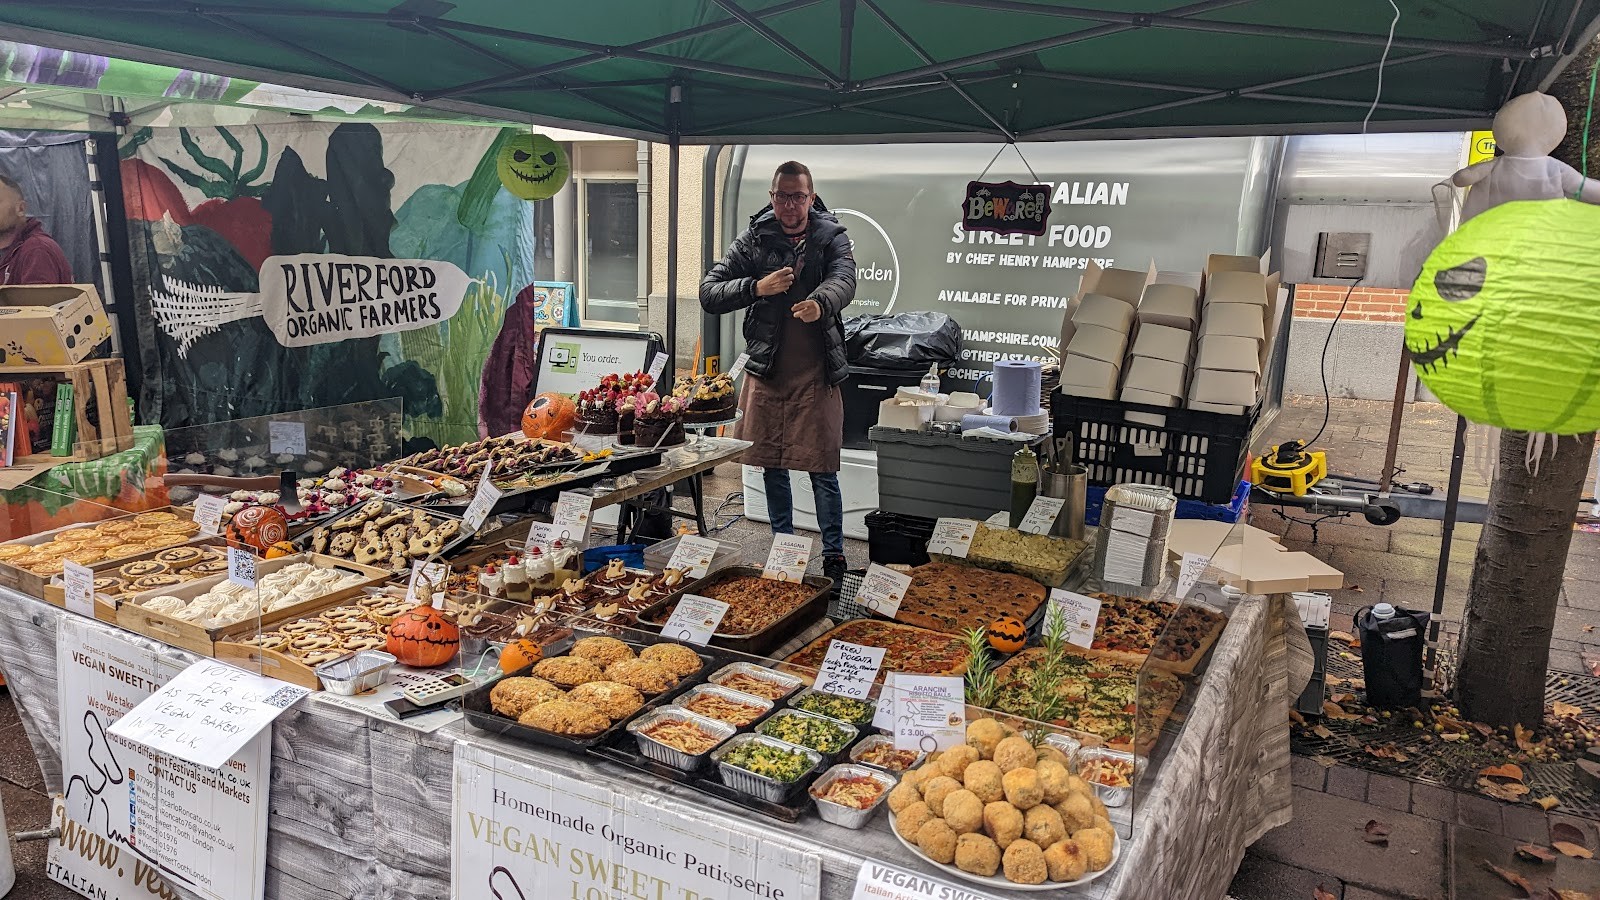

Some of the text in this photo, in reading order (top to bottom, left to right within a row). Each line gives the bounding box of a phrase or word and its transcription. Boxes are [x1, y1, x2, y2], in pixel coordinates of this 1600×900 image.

[1033, 181, 1130, 205] ALIAN
[1048, 224, 1112, 249] FOOD
[947, 252, 1115, 270] BY CHEF HENRY HAMPSRE
[280, 262, 437, 317] RIVERFORD
[938, 290, 1002, 306] AVAILABLE
[1004, 292, 1028, 306] FOR
[287, 292, 442, 338] ORGANIC FARMERS
[582, 352, 597, 363] You
[711, 359, 720, 374] R
[780, 540, 806, 549] LASAGNA
[82, 642, 106, 658] Organic
[108, 652, 135, 669] Homemade
[833, 641, 863, 655] GREEN
[840, 652, 872, 665] POLENTA
[72, 650, 106, 674] VEGAN
[109, 665, 144, 690] SWEET
[201, 665, 247, 682] VOTE
[396, 672, 426, 682] CARD
[202, 682, 262, 703] FOR US
[392, 681, 413, 689] PA
[913, 685, 947, 693] ARANCINI
[87, 695, 99, 709] We
[106, 690, 134, 711] We take
[162, 686, 256, 716] AS THE BEST
[154, 701, 246, 738] VEGAN BAKERY
[151, 722, 175, 739] THE
[900, 728, 906, 736] £
[907, 729, 924, 737] 3.00
[119, 737, 127, 748] us
[127, 741, 137, 753] on
[137, 745, 168, 767] different
[168, 757, 201, 782] Festivals
[201, 775, 217, 790] and
[217, 780, 251, 805] Markets
[147, 763, 197, 794] CONTACT US
[136, 806, 155, 823] Vegan
[173, 823, 191, 841] Tooth
[192, 832, 214, 853] London
[492, 787, 596, 837] Homemade
[601, 823, 678, 866] Organic
[683, 850, 785, 899] Patisserie
[467, 811, 671, 900] VEGAN SWEET
[48, 862, 107, 900] ITALIAN
[871, 864, 936, 896] VEGAN
[864, 883, 894, 899] Italian
